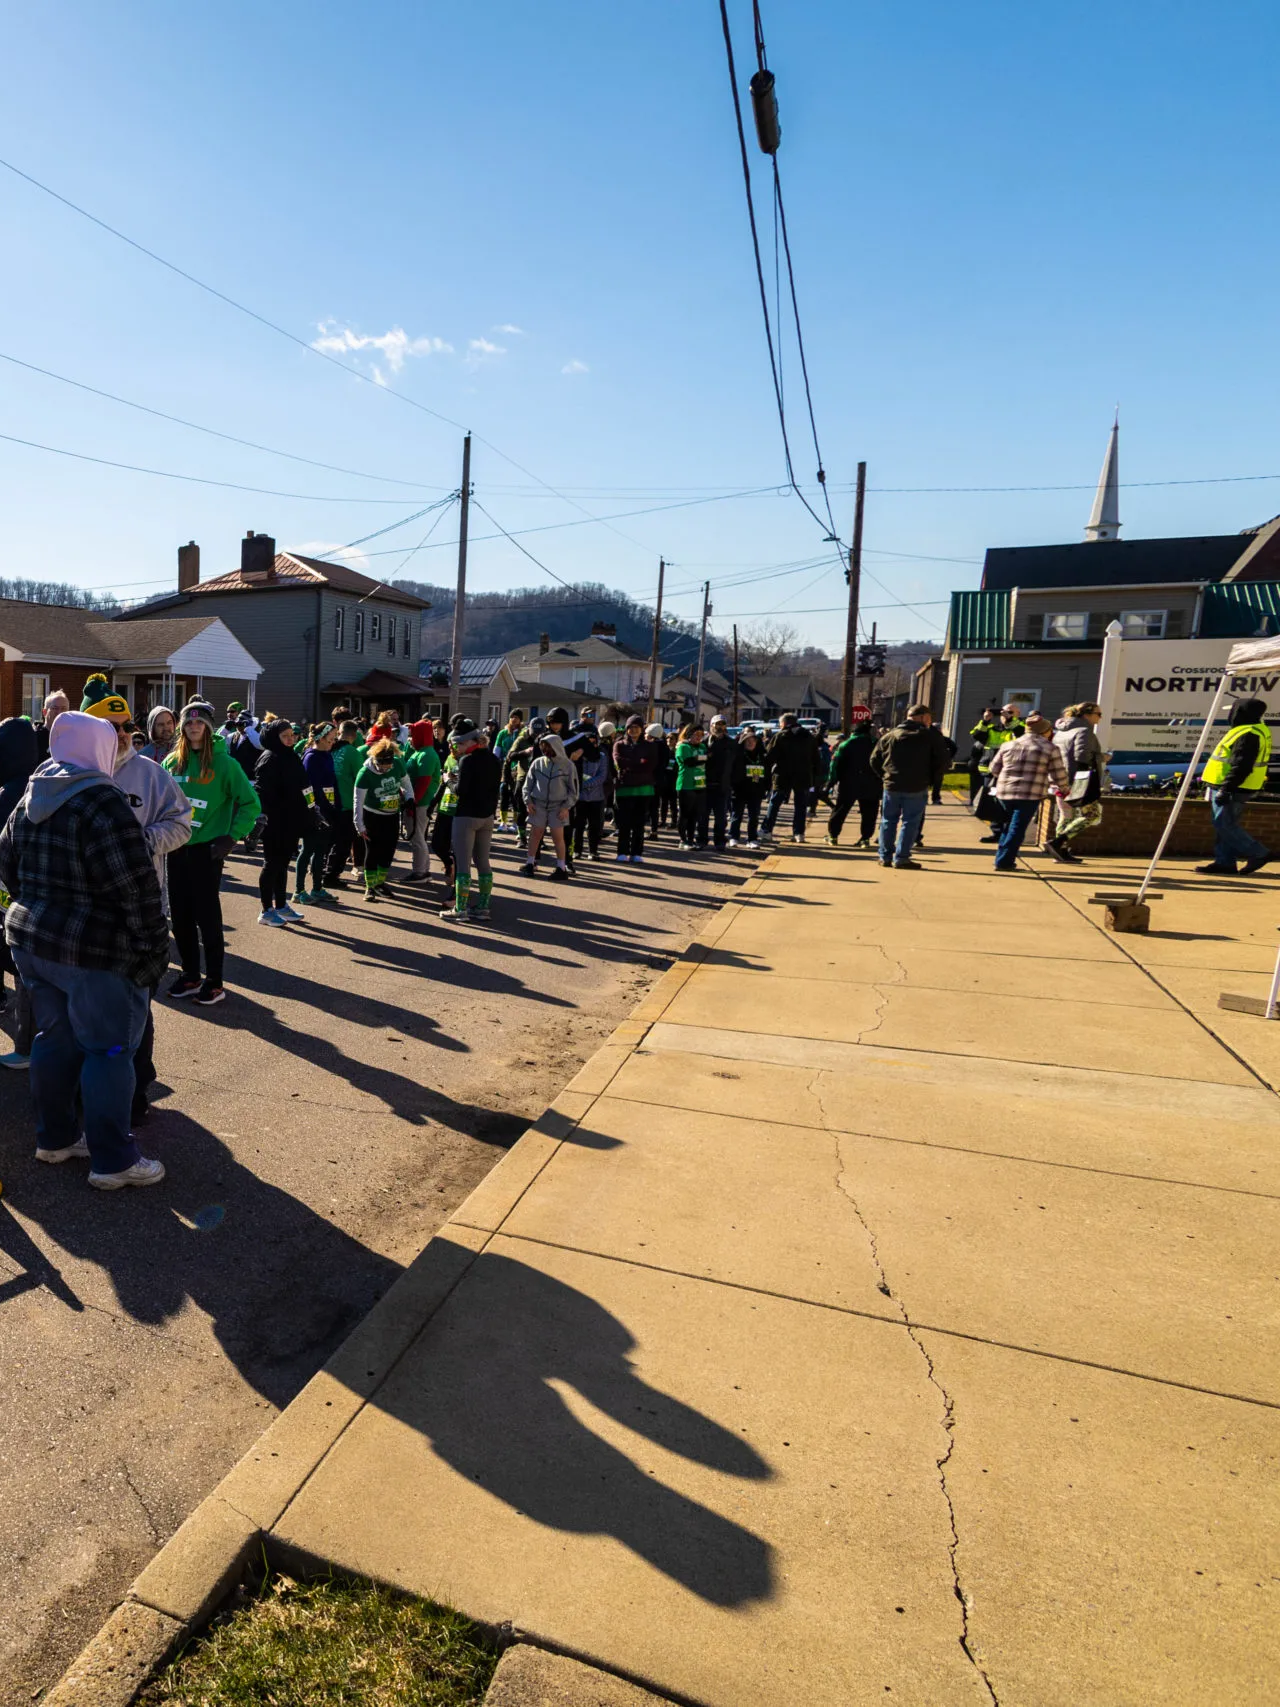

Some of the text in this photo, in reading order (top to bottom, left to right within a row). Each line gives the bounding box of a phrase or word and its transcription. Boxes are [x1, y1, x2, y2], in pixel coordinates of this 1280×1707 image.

[1171, 665, 1227, 674] Crossroa
[1125, 676, 1280, 692] NORTH RIV
[853, 711, 870, 720] TOP
